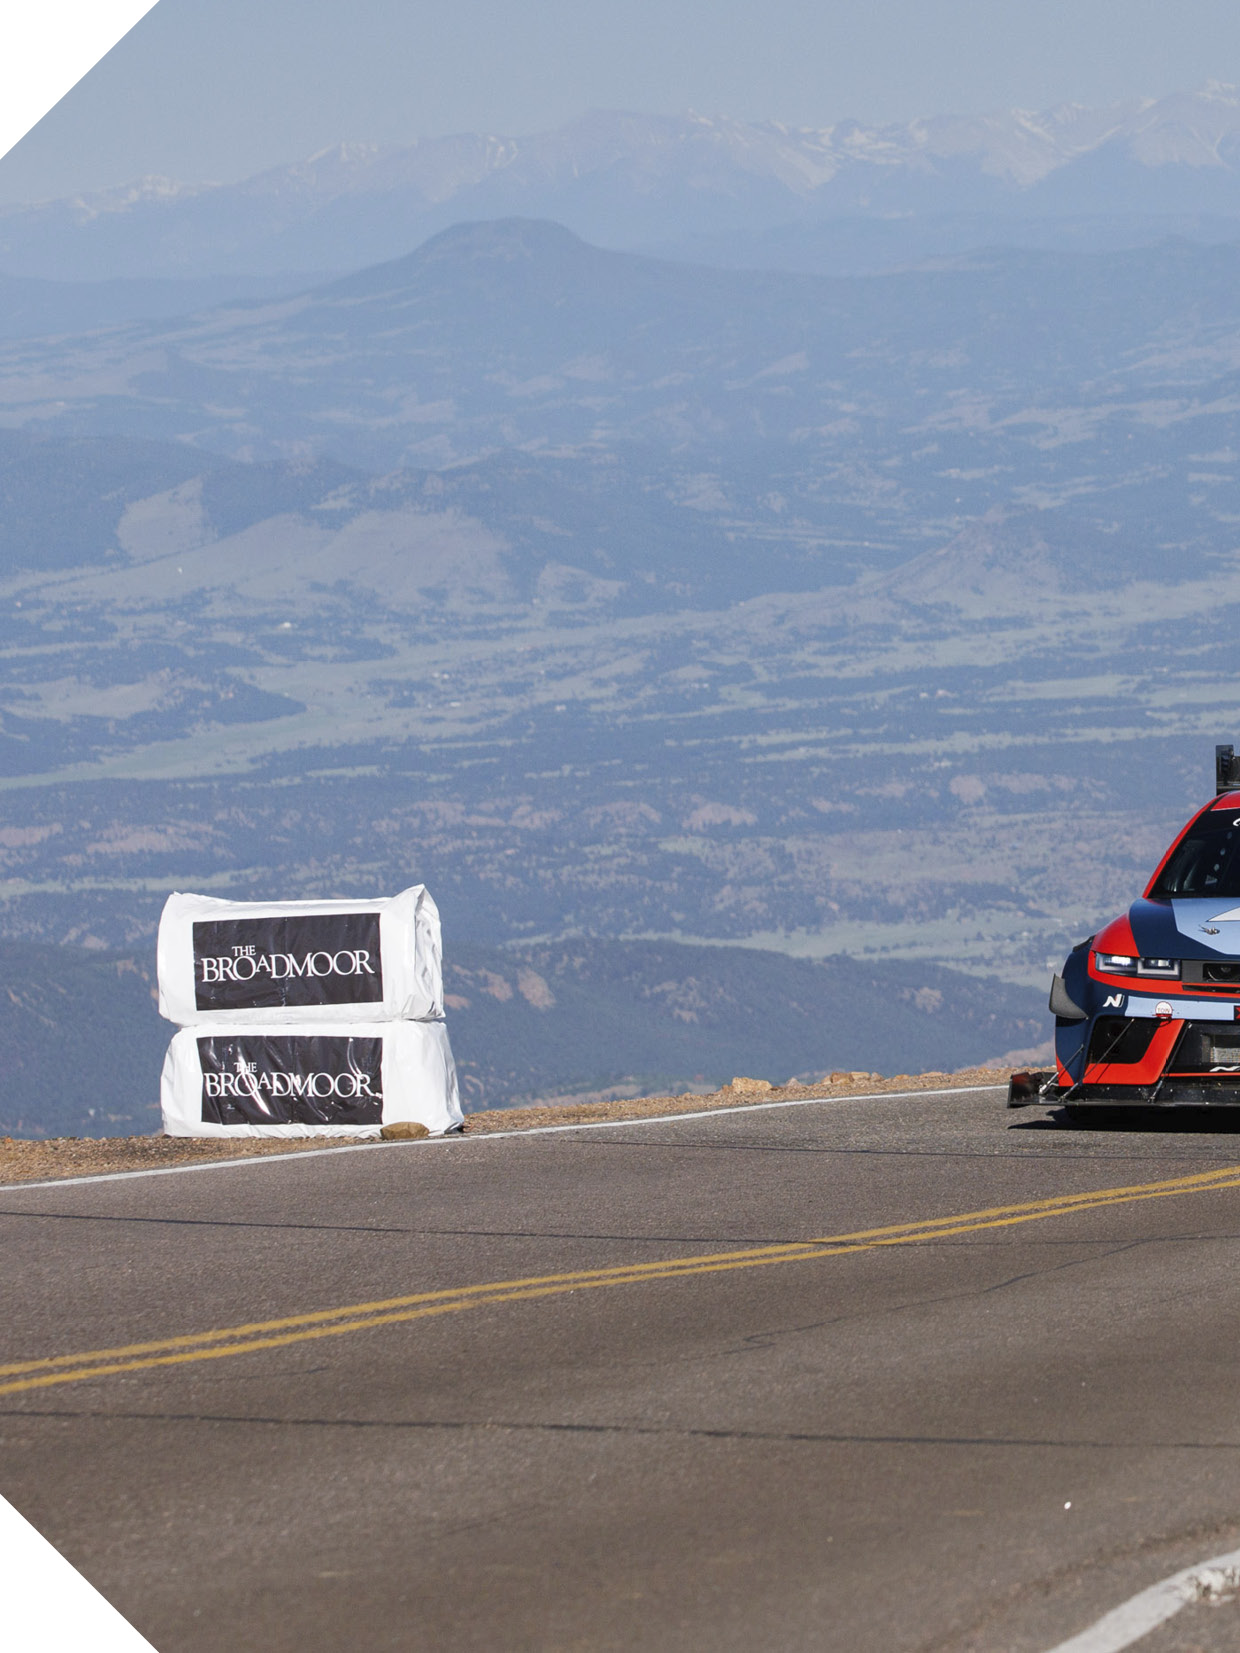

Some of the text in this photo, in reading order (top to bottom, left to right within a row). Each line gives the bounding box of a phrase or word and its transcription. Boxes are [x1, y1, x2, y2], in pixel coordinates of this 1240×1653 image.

[231, 945, 256, 957] THE
[200, 950, 375, 982] BROADMOOR
[233, 1062, 257, 1073] THE
[204, 1072, 375, 1098] BROADMOOR
